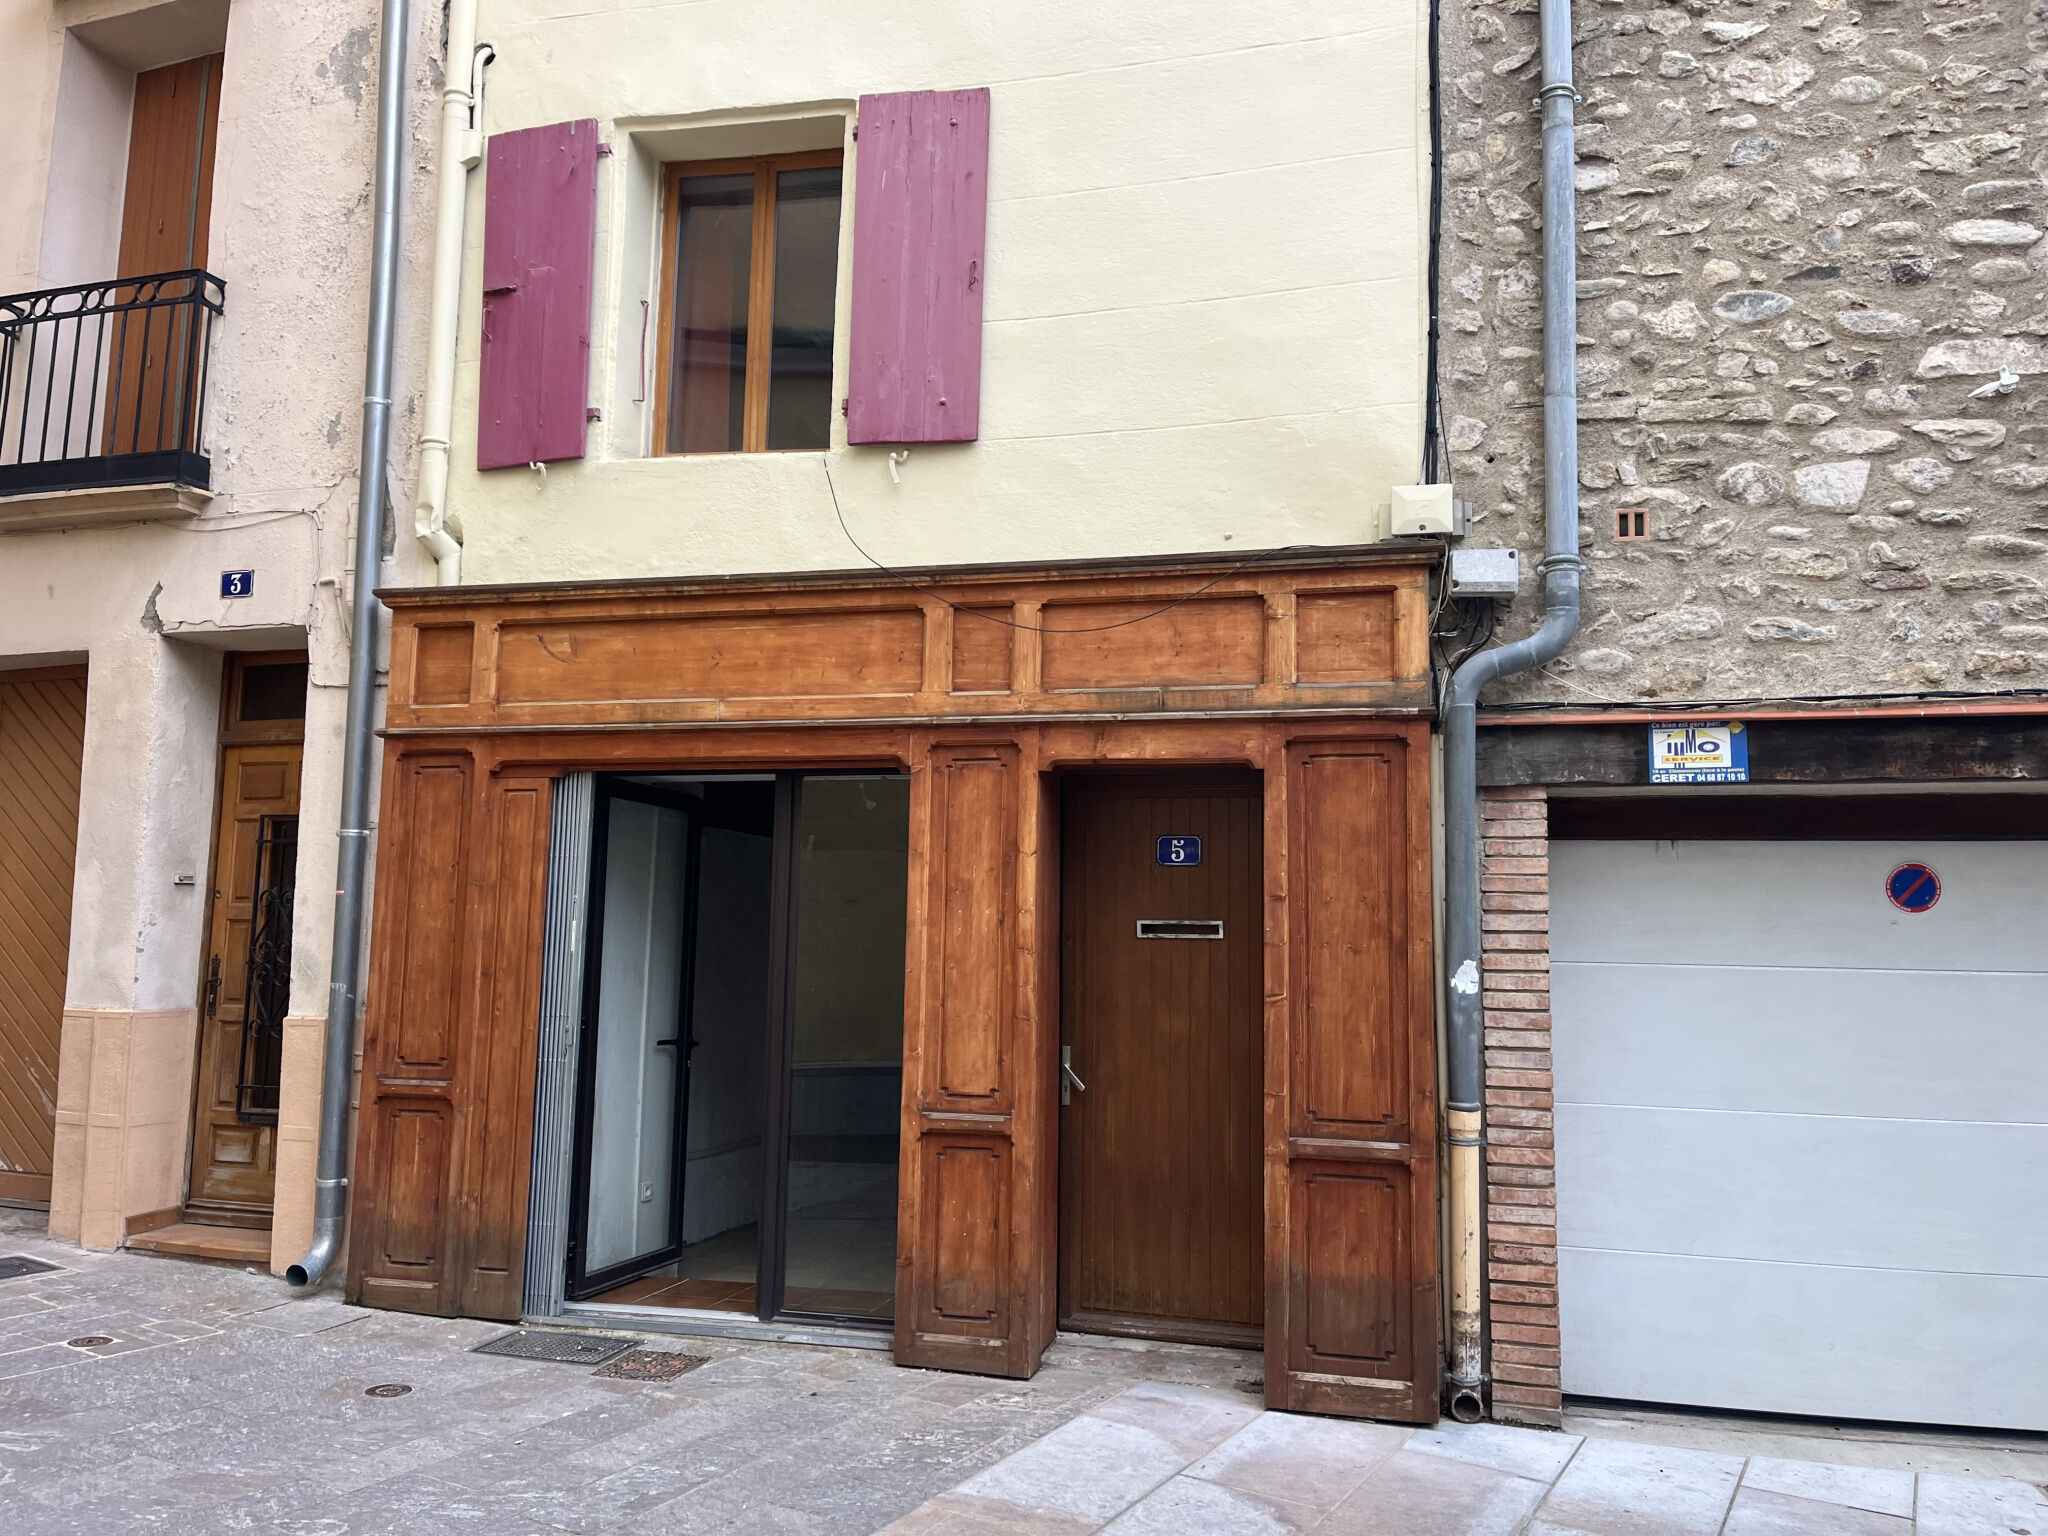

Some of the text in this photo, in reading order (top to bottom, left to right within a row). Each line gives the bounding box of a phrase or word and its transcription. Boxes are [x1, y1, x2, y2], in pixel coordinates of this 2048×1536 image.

[230, 574, 242, 594] 3
[1667, 729, 1720, 768] IMMO
[1652, 774, 1695, 782] CERET
[1171, 839, 1185, 862] 5
